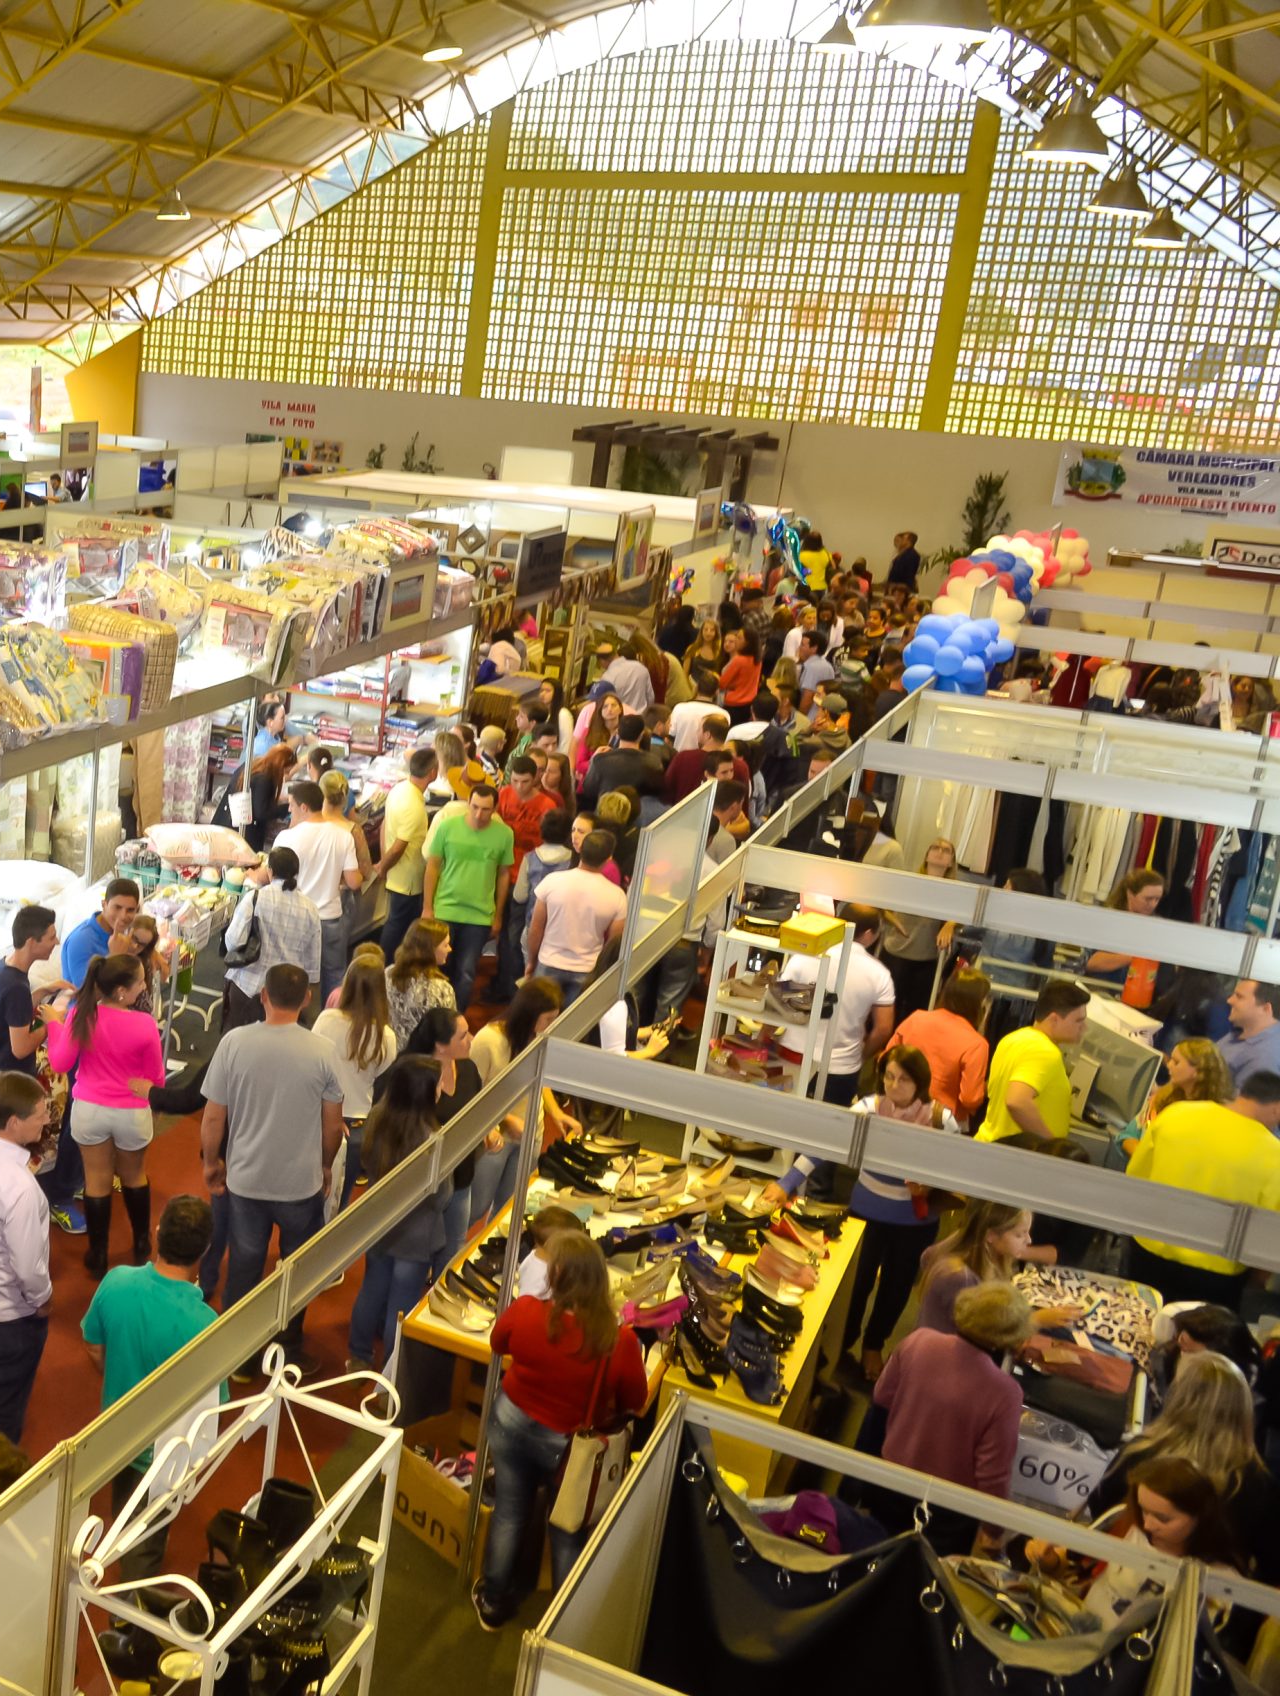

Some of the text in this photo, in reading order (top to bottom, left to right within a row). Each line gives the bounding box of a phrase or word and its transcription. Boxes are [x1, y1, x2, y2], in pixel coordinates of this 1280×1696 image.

[261, 400, 316, 414] VILA MARIA
[269, 417, 315, 429] EM FOTO
[1136, 451, 1275, 472] CÂMARA MUNICIPAL
[1168, 471, 1256, 488] VEREADORES
[1196, 488, 1223, 496] MARIA
[1137, 494, 1198, 508] APOIANDO
[1200, 500, 1228, 511] ESTE
[1231, 502, 1276, 513] EVENTO
[1019, 1456, 1090, 1496] 60%
[397, 1491, 460, 1557] LUPO
